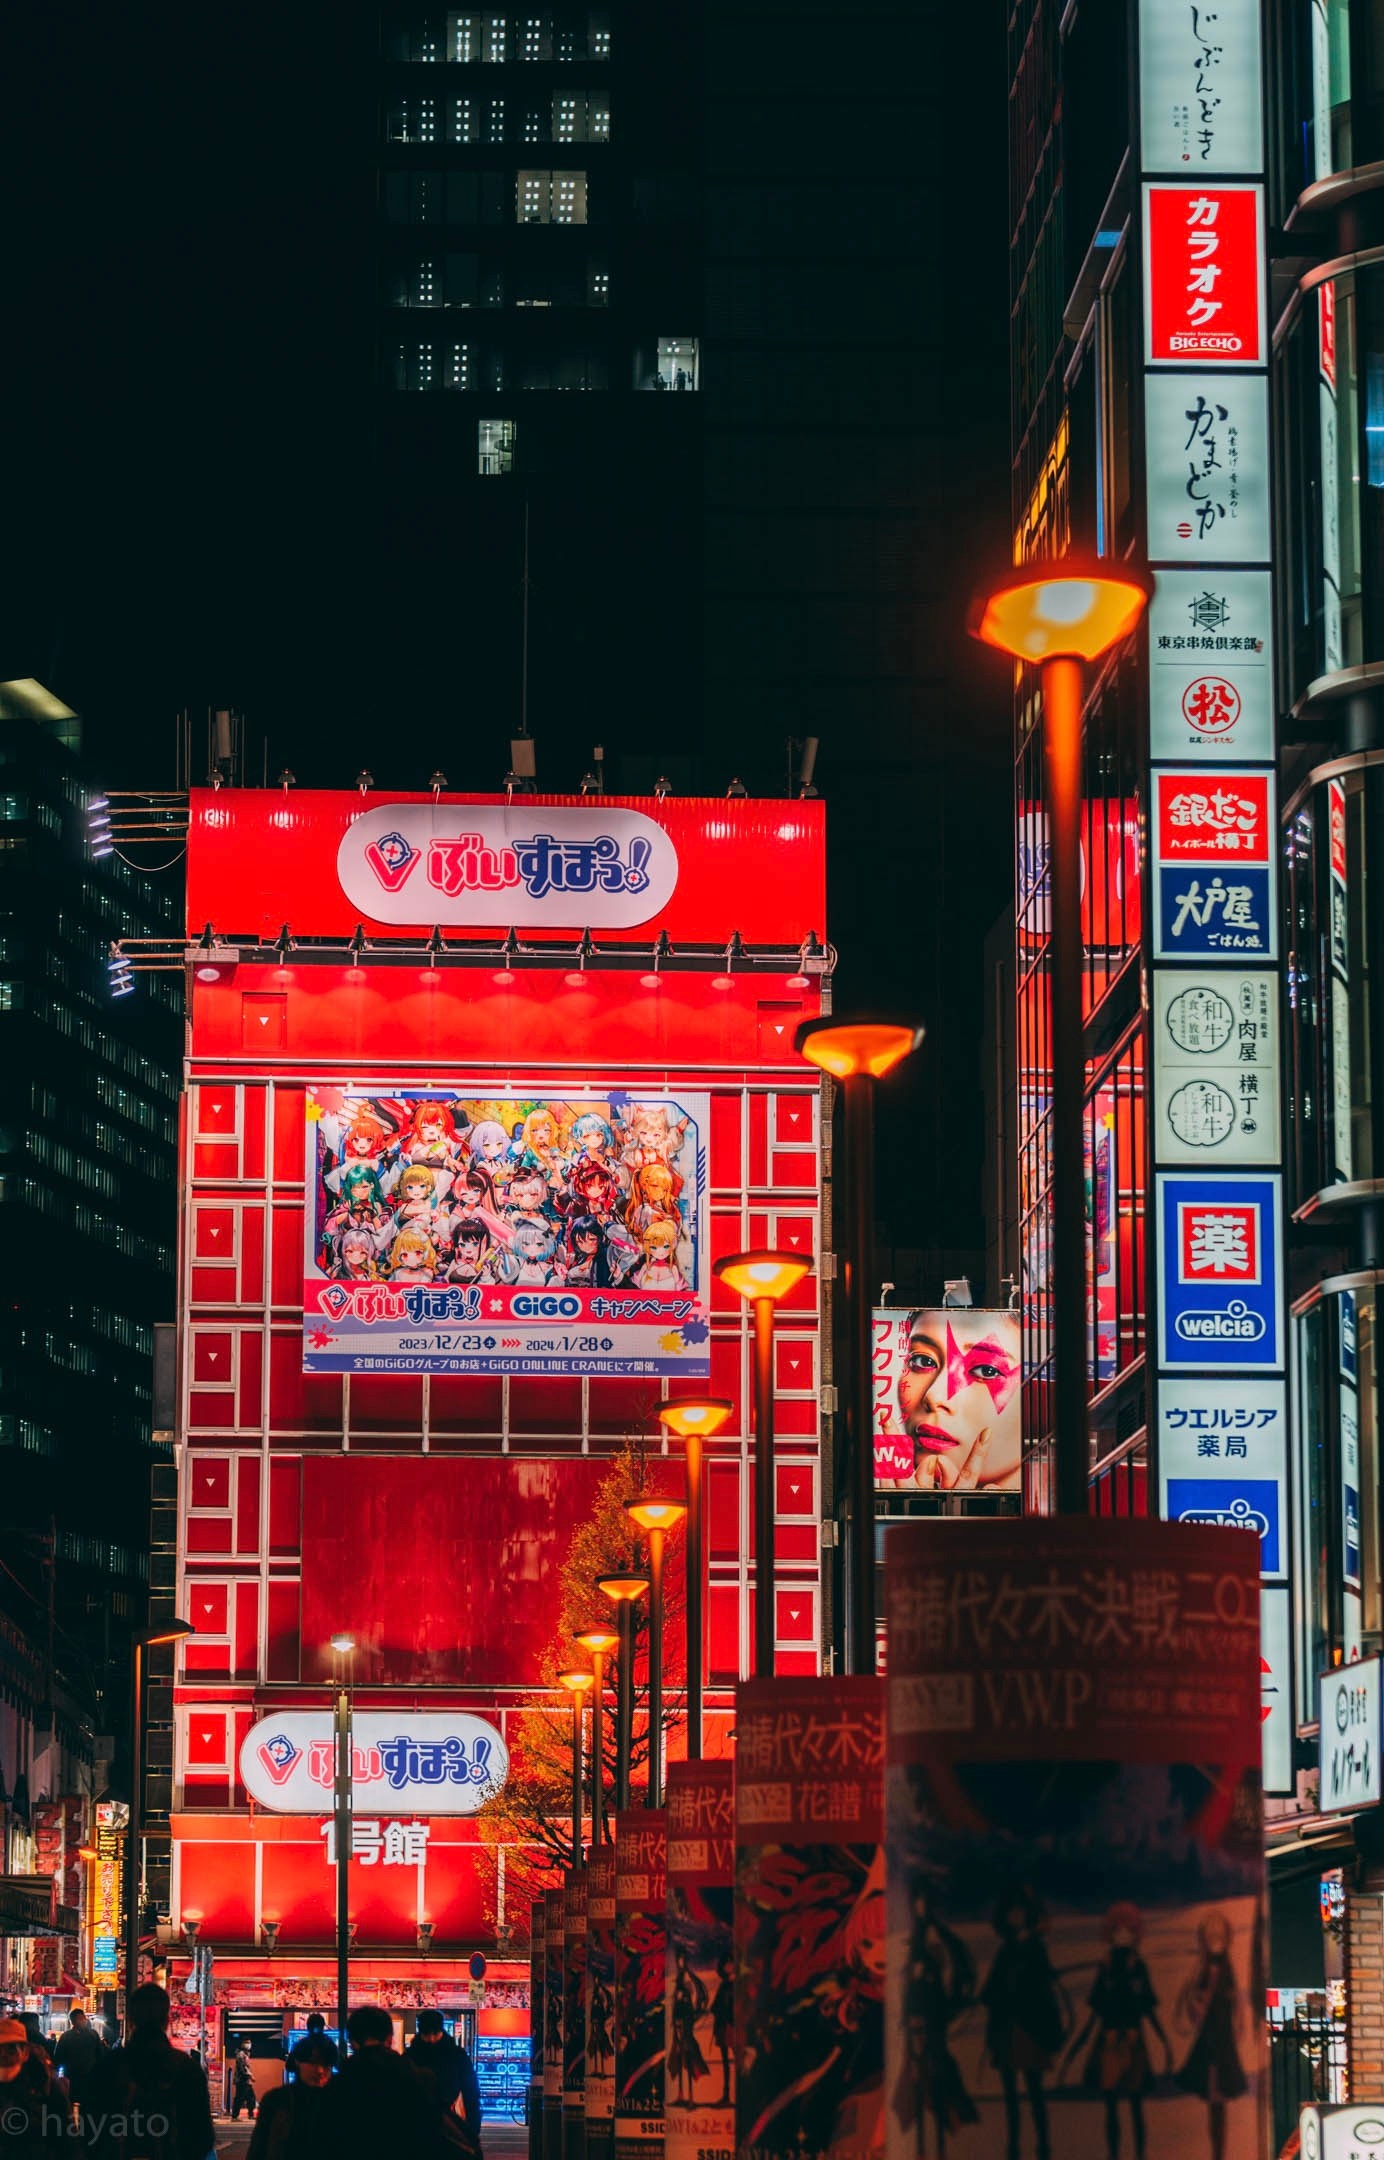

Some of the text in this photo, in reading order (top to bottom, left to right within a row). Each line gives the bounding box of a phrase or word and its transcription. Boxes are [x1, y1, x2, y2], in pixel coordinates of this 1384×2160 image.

[1190, 4, 1223, 160] じぶんどき
[1186, 197, 1222, 326] カラオケ
[1169, 336, 1242, 351] BIG ECHO
[1185, 396, 1228, 540] かまどか
[1188, 684, 1234, 725] 松
[1168, 788, 1258, 830] 銀だこ
[1171, 877, 1260, 937] 大戸屋
[1201, 1000, 1224, 1045] 和牛
[1201, 1093, 1223, 1138] 和牛
[1190, 1214, 1249, 1272] 薬
[513, 1296, 579, 1316] GiGO
[590, 1296, 693, 1318] キャンペーン
[1182, 1314, 1255, 1337] welcia
[399, 1335, 481, 1350] 2023/12/23
[526, 1336, 598, 1351] 2024/1/28
[872, 1319, 893, 1427] ワクワク
[1165, 1408, 1277, 1429] ウエルシア
[1197, 1435, 1248, 1458] 薬局
